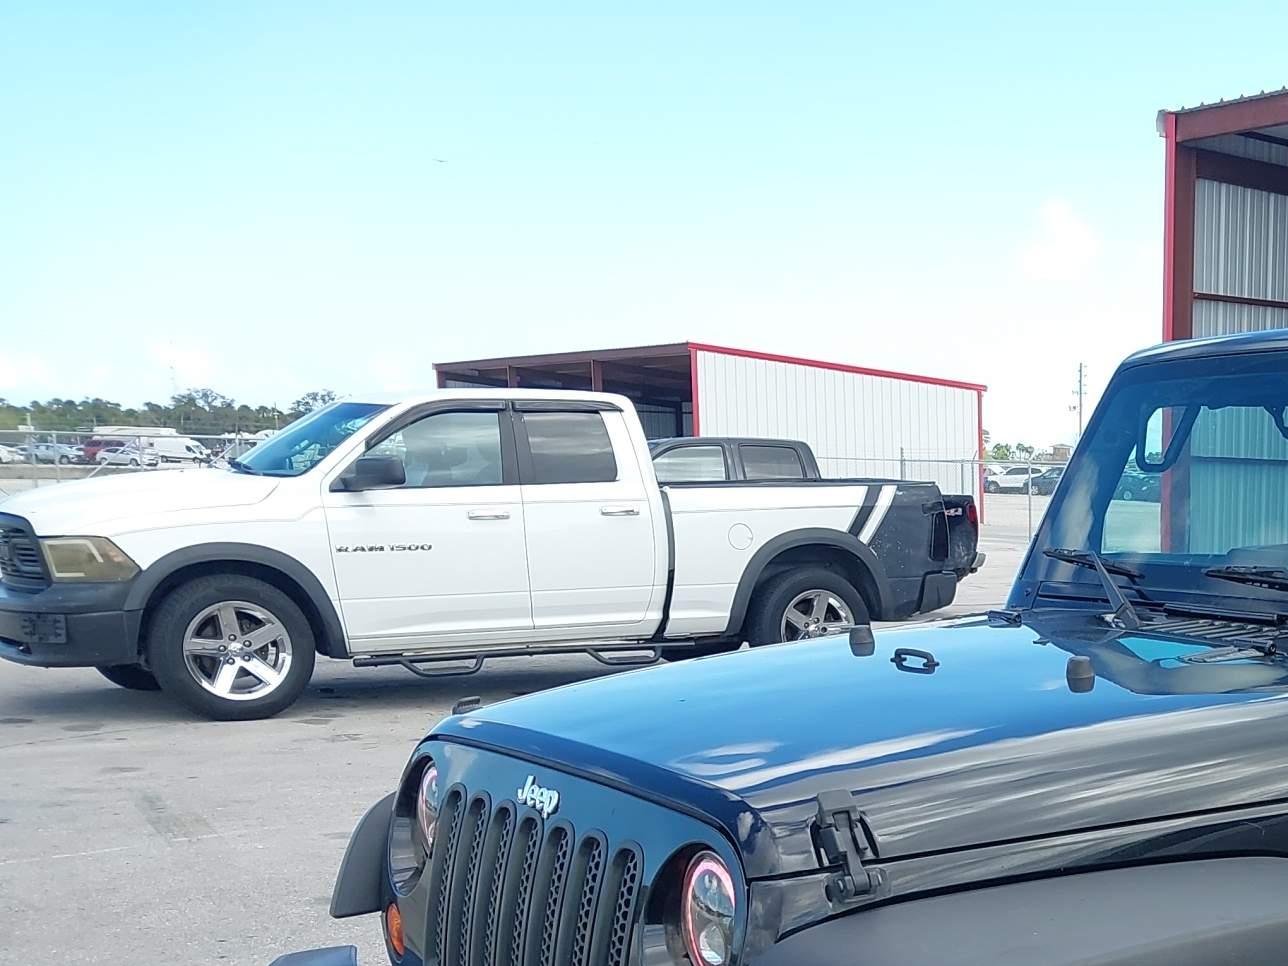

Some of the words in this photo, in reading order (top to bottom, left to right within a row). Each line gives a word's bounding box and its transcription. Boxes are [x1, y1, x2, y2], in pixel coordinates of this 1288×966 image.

[336, 545, 385, 553] RAM
[388, 544, 433, 552] 1500
[517, 775, 559, 819] Jeep
